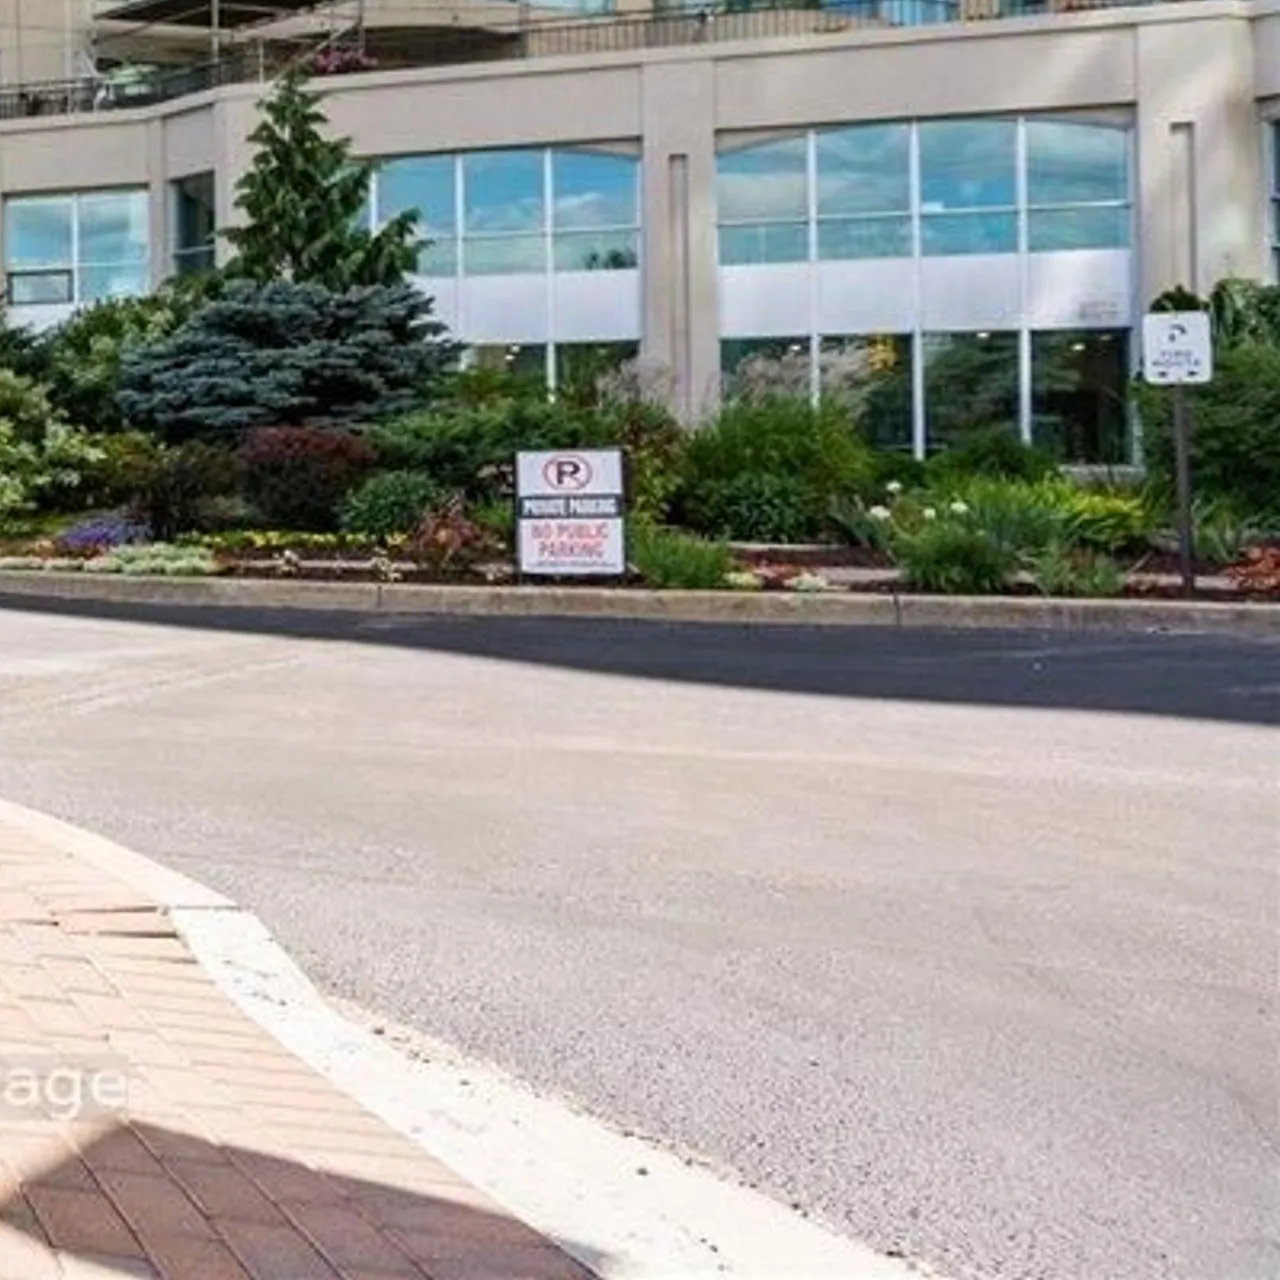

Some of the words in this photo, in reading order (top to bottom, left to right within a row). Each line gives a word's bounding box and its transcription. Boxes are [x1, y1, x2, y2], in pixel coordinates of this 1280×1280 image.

[530, 523, 552, 539] NO
[556, 522, 609, 539] PUBLIC
[538, 540, 604, 558] PARKING
